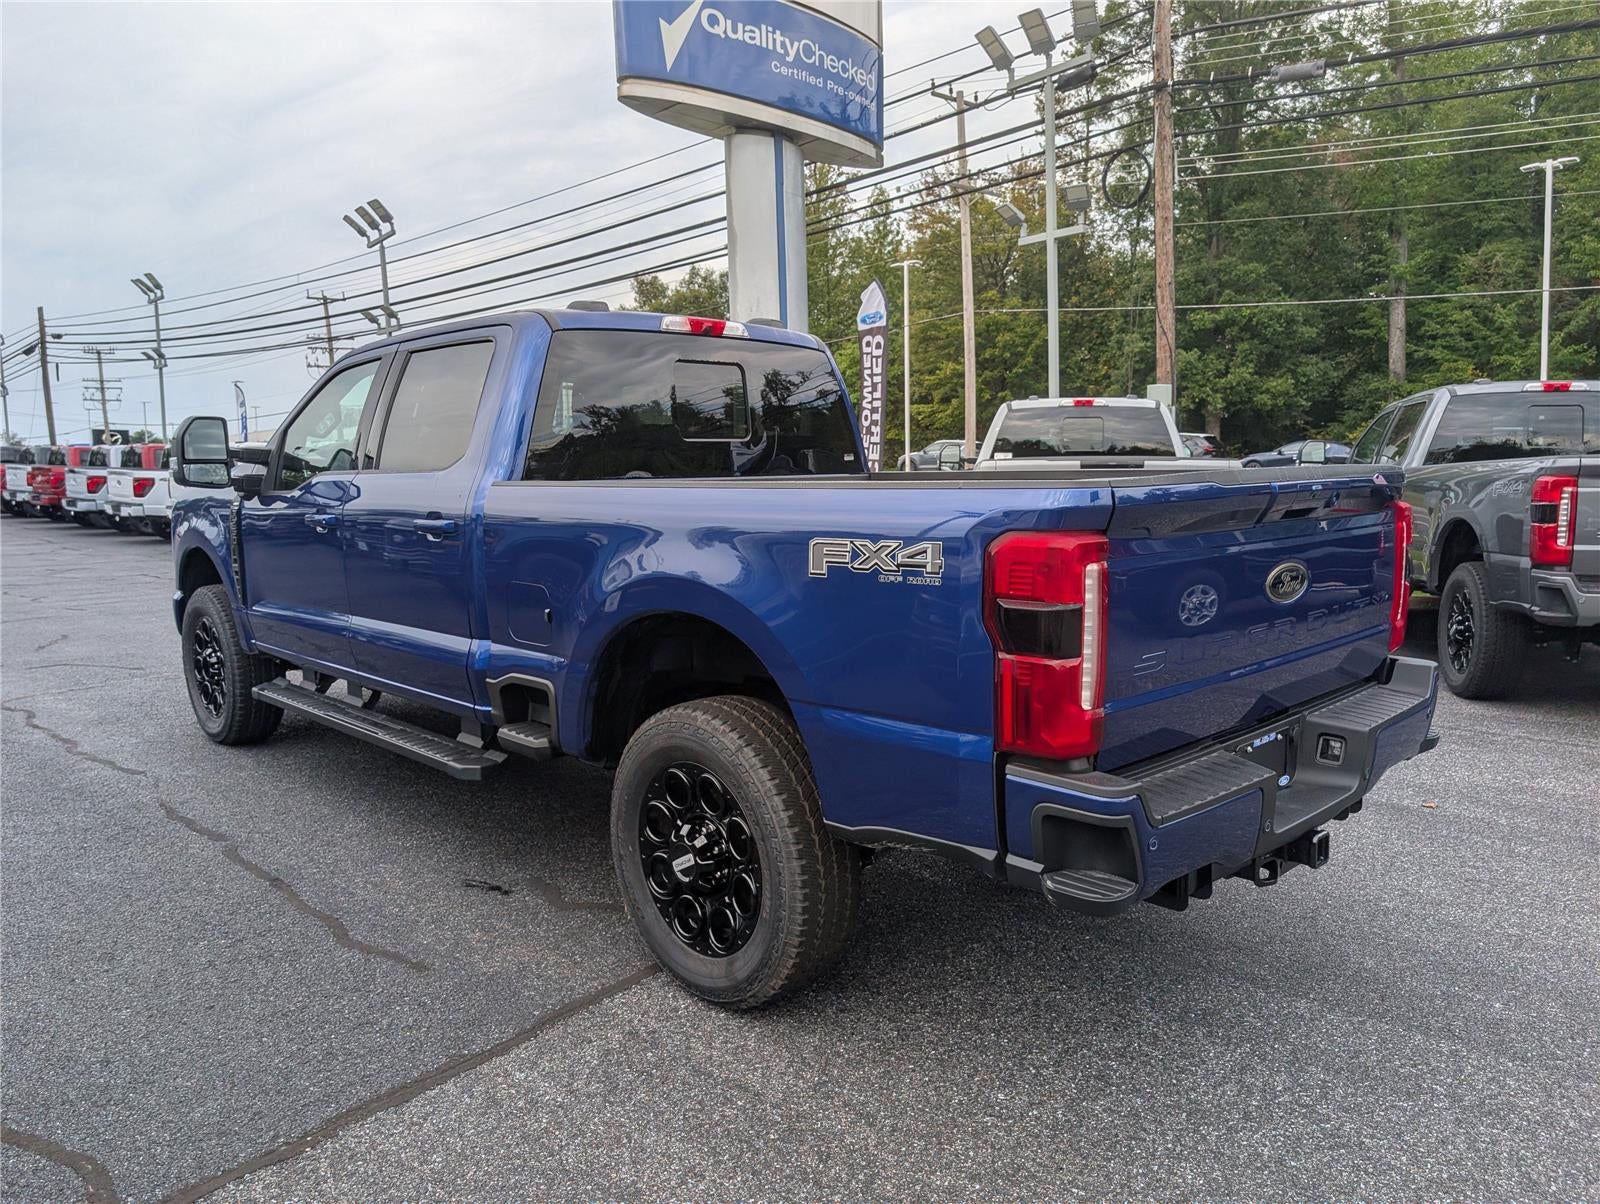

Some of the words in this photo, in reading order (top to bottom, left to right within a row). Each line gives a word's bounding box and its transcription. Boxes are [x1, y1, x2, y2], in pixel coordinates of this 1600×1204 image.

[771, 61, 823, 88] Certified
[827, 80, 876, 112] Pre-owned
[1492, 480, 1525, 497] FX4
[808, 537, 944, 578] FX4
